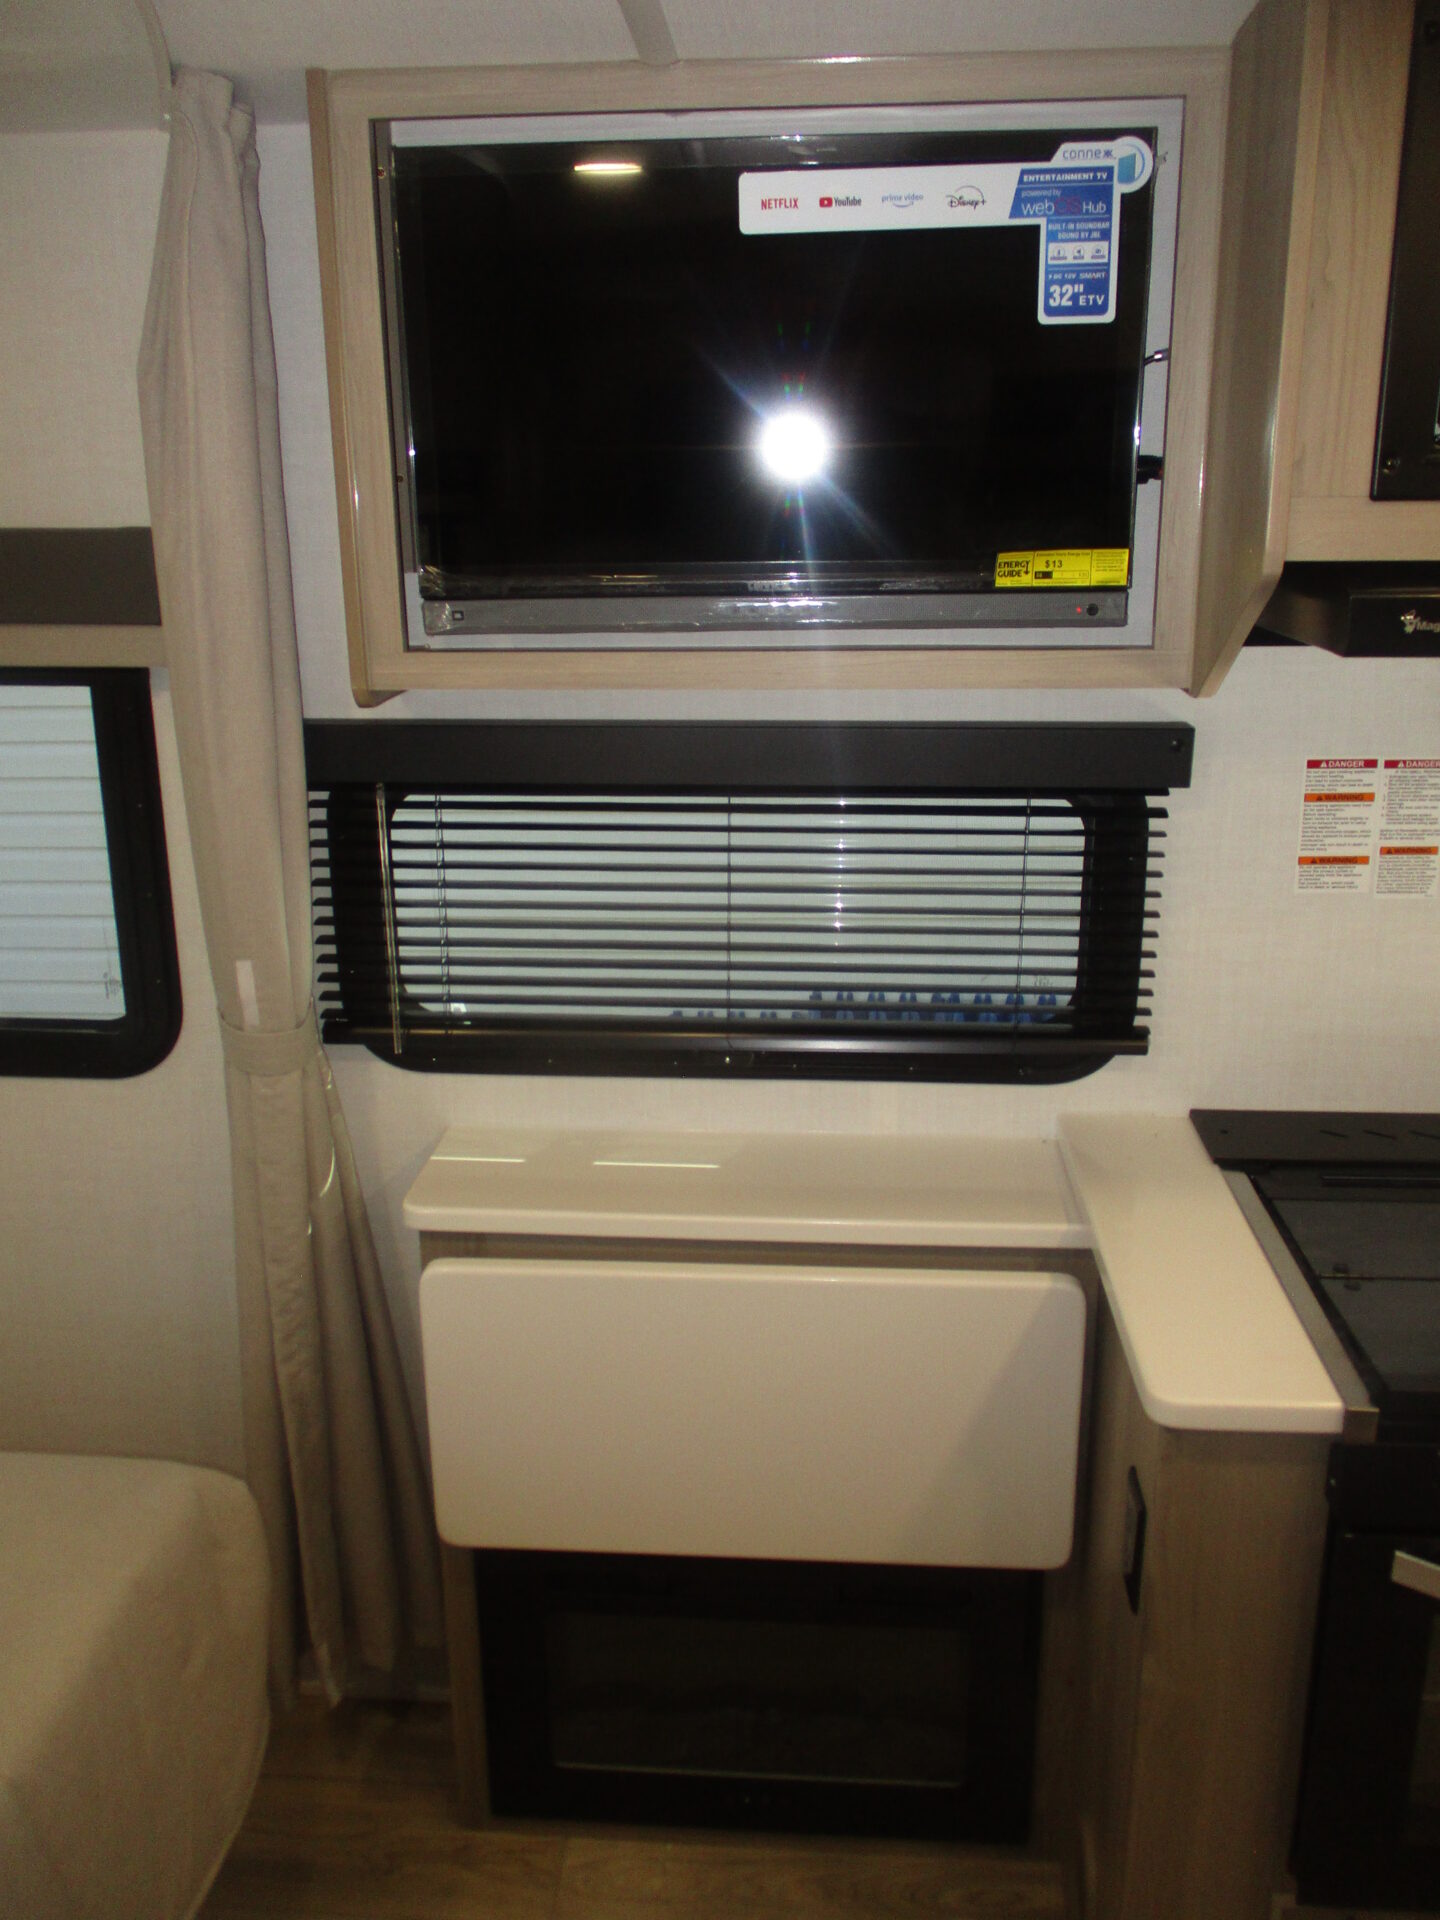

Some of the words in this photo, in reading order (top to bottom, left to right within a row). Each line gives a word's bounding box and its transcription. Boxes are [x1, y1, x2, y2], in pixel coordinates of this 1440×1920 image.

[1023, 171, 1093, 182] ENTERTAINMENT
[1097, 171, 1108, 180] TV
[1052, 187, 1061, 197] by
[834, 196, 862, 208] YouTube
[881, 193, 902, 203] prime
[904, 192, 924, 202] video
[760, 197, 799, 210] NETFLIX
[1021, 198, 1081, 216] webOS
[1082, 200, 1107, 214] Hub
[1079, 271, 1106, 280] SMART
[1048, 283, 1084, 307] 32"
[1079, 294, 1105, 305] ETV
[997, 559, 1030, 569] ENERGY
[1045, 559, 1063, 569] $13
[997, 569, 1023, 578] GUIDE
[1328, 760, 1365, 768] DANGER
[1325, 793, 1365, 801] WARNING
